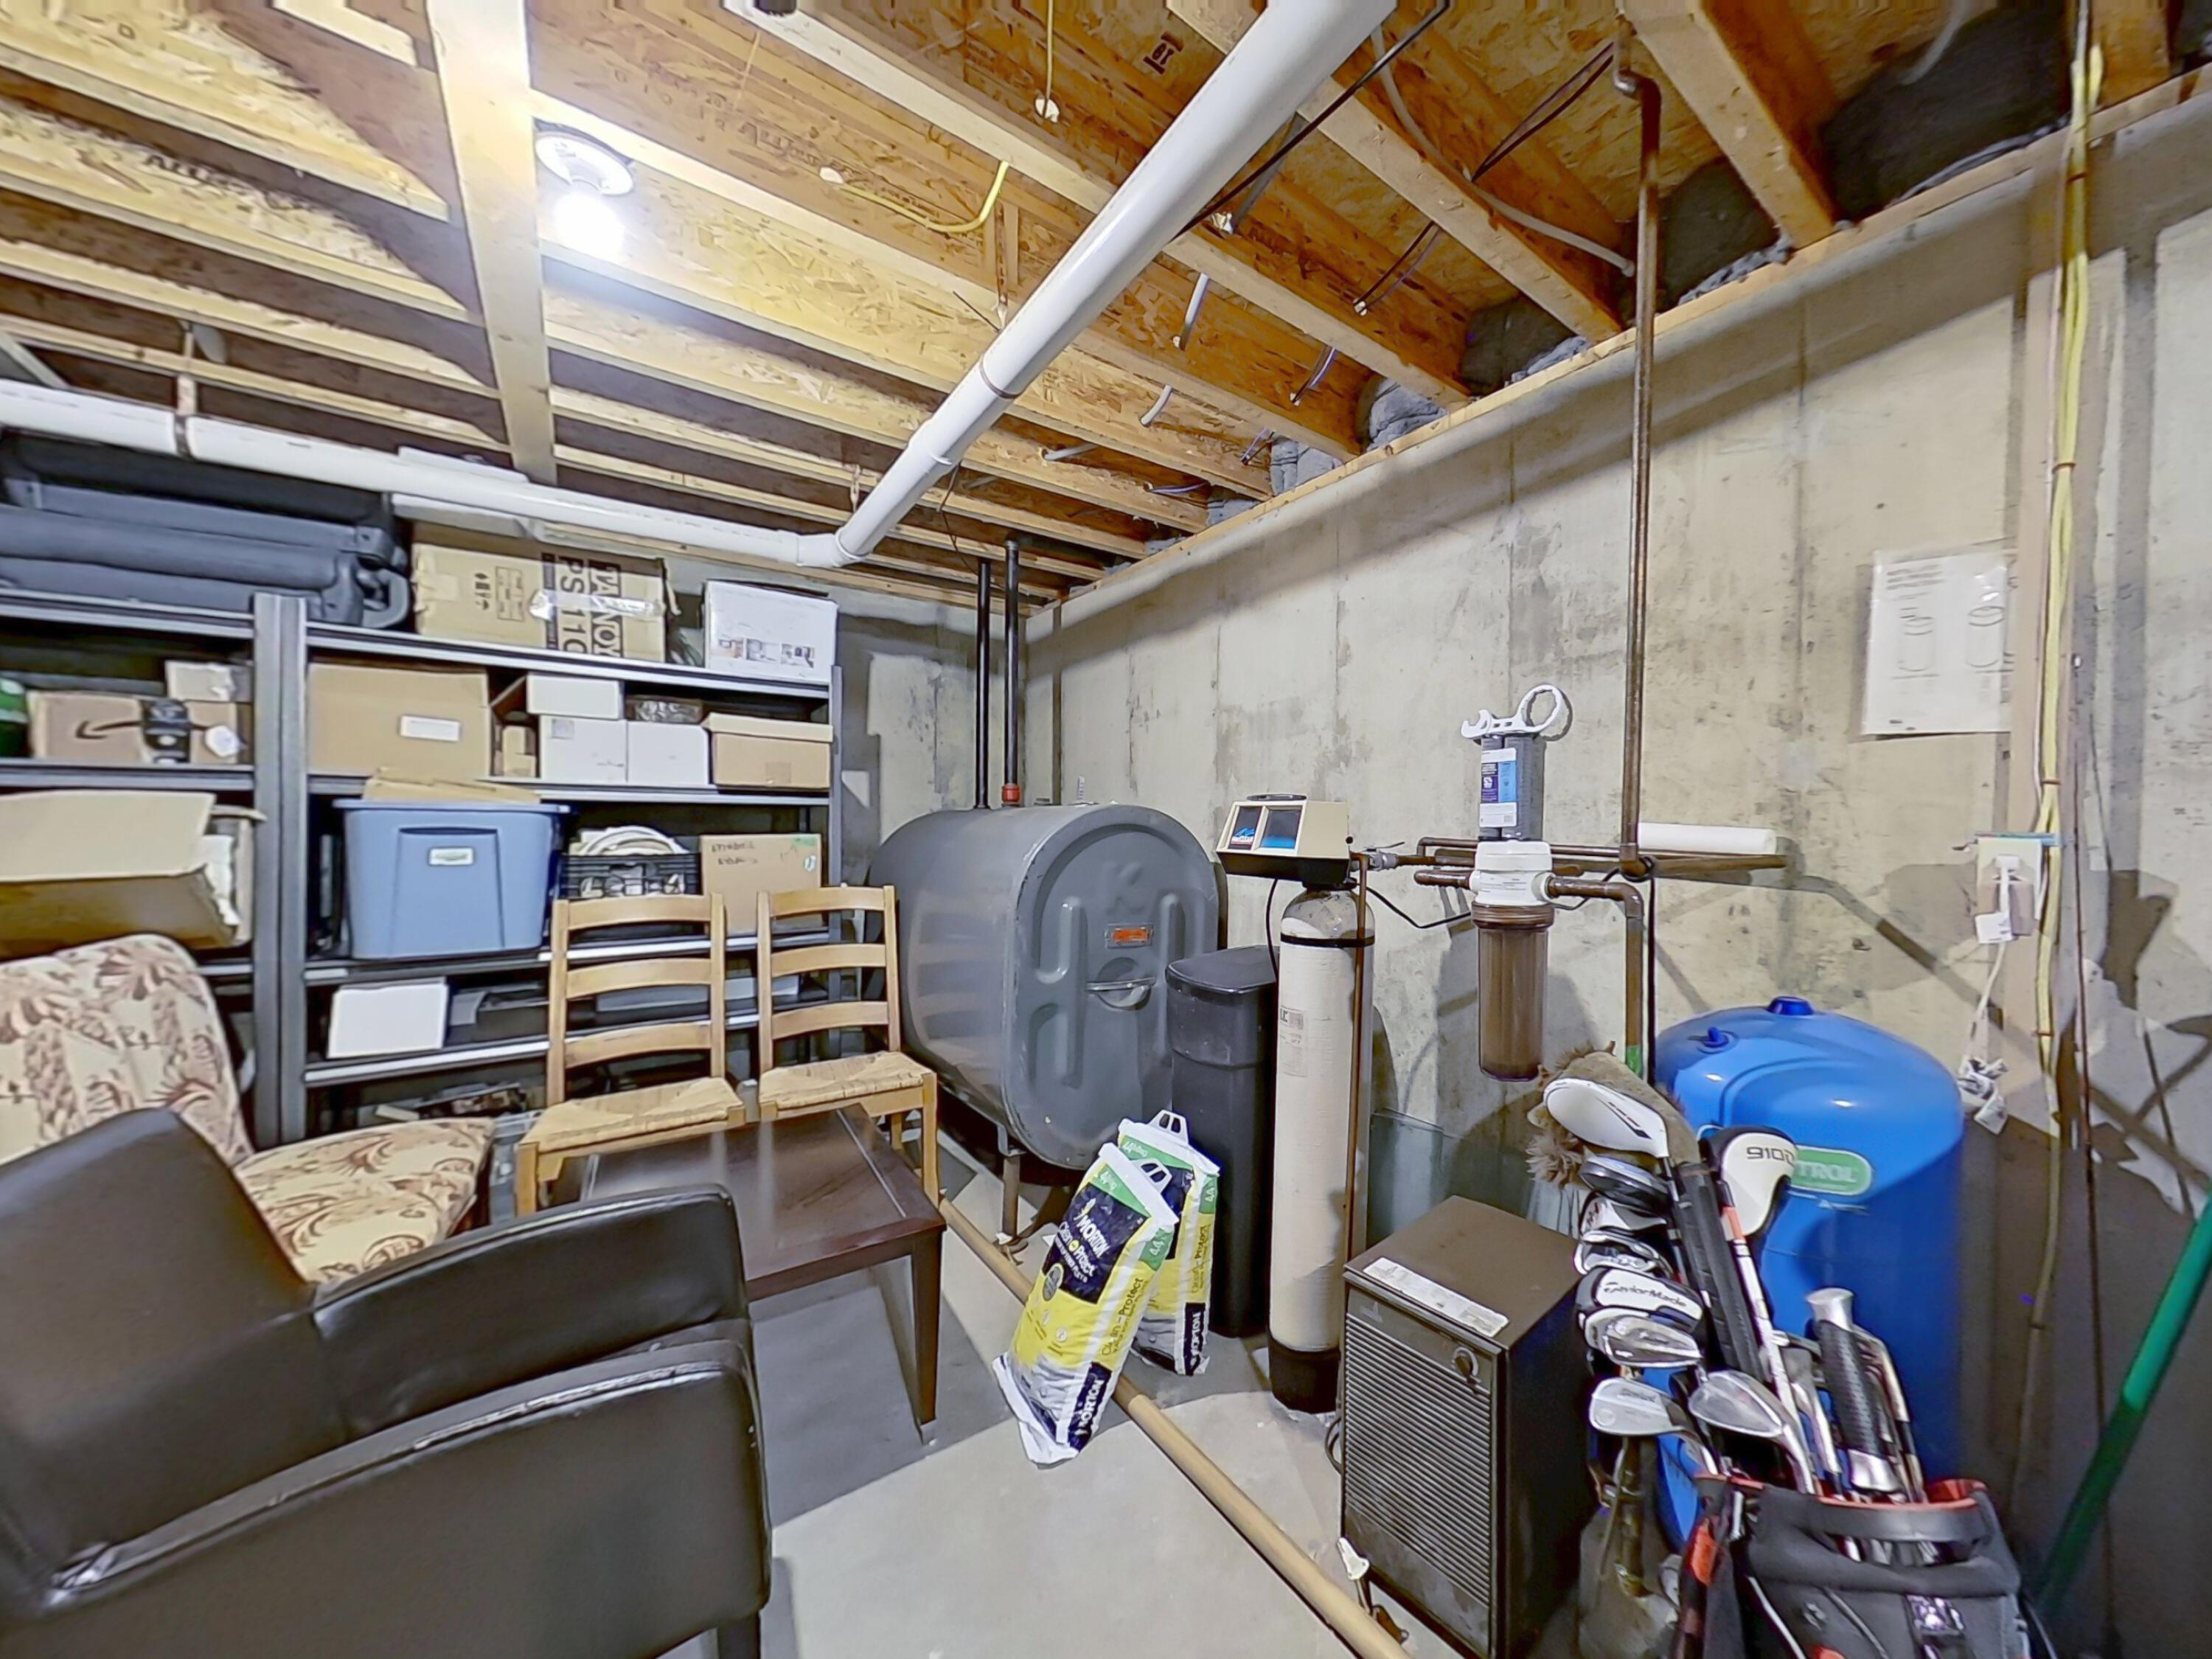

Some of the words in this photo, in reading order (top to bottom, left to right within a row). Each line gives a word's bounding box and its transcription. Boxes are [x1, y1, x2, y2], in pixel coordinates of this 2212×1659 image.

[591, 563, 621, 657] TANOY
[1077, 1214, 1110, 1259] MORTON
[1604, 1281, 1687, 1307] TaylorMade
